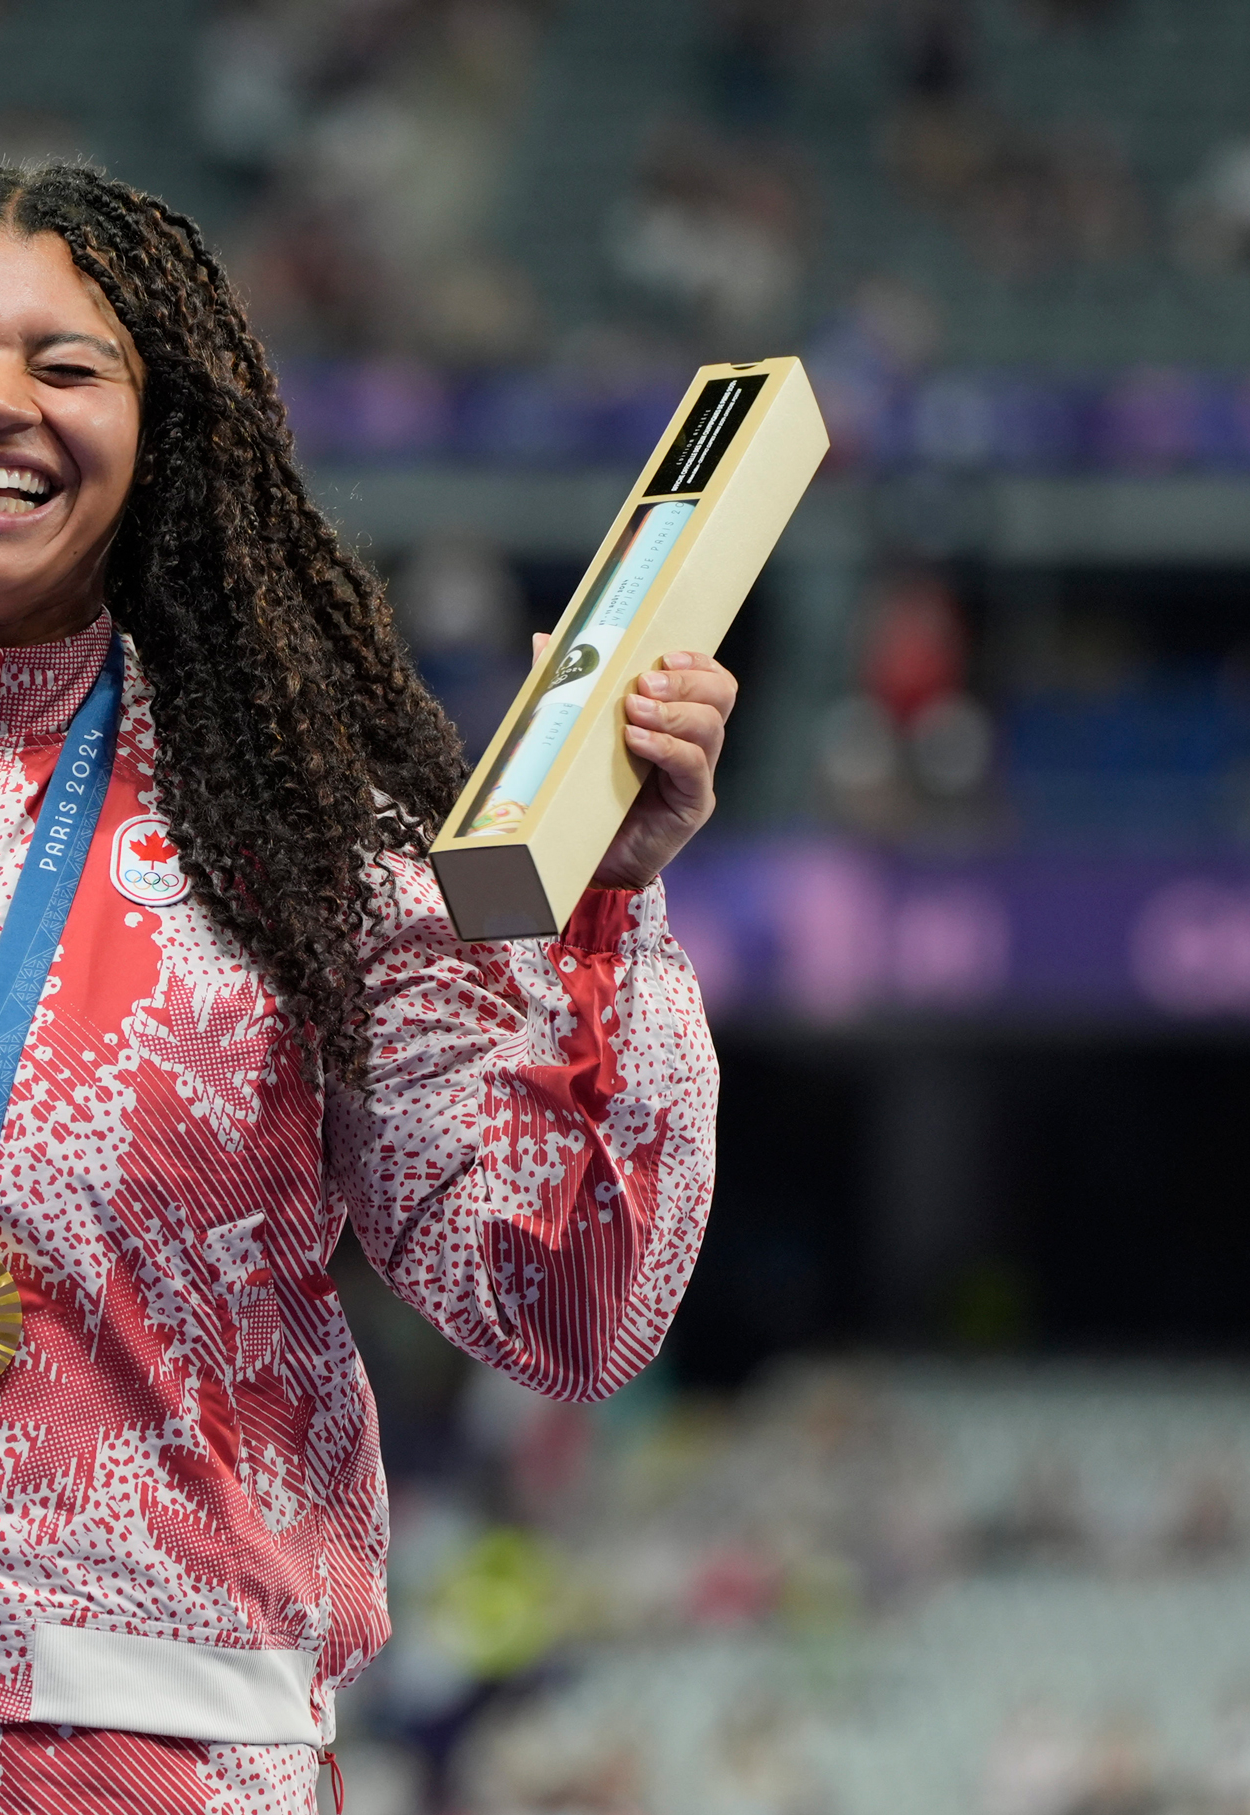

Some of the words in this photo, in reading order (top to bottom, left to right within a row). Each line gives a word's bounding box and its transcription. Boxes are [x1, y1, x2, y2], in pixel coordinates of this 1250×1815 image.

[542, 721, 563, 746] JEUX
[640, 558, 654, 569] DE
[650, 521, 675, 551] PARIS
[65, 729, 104, 796] 2024
